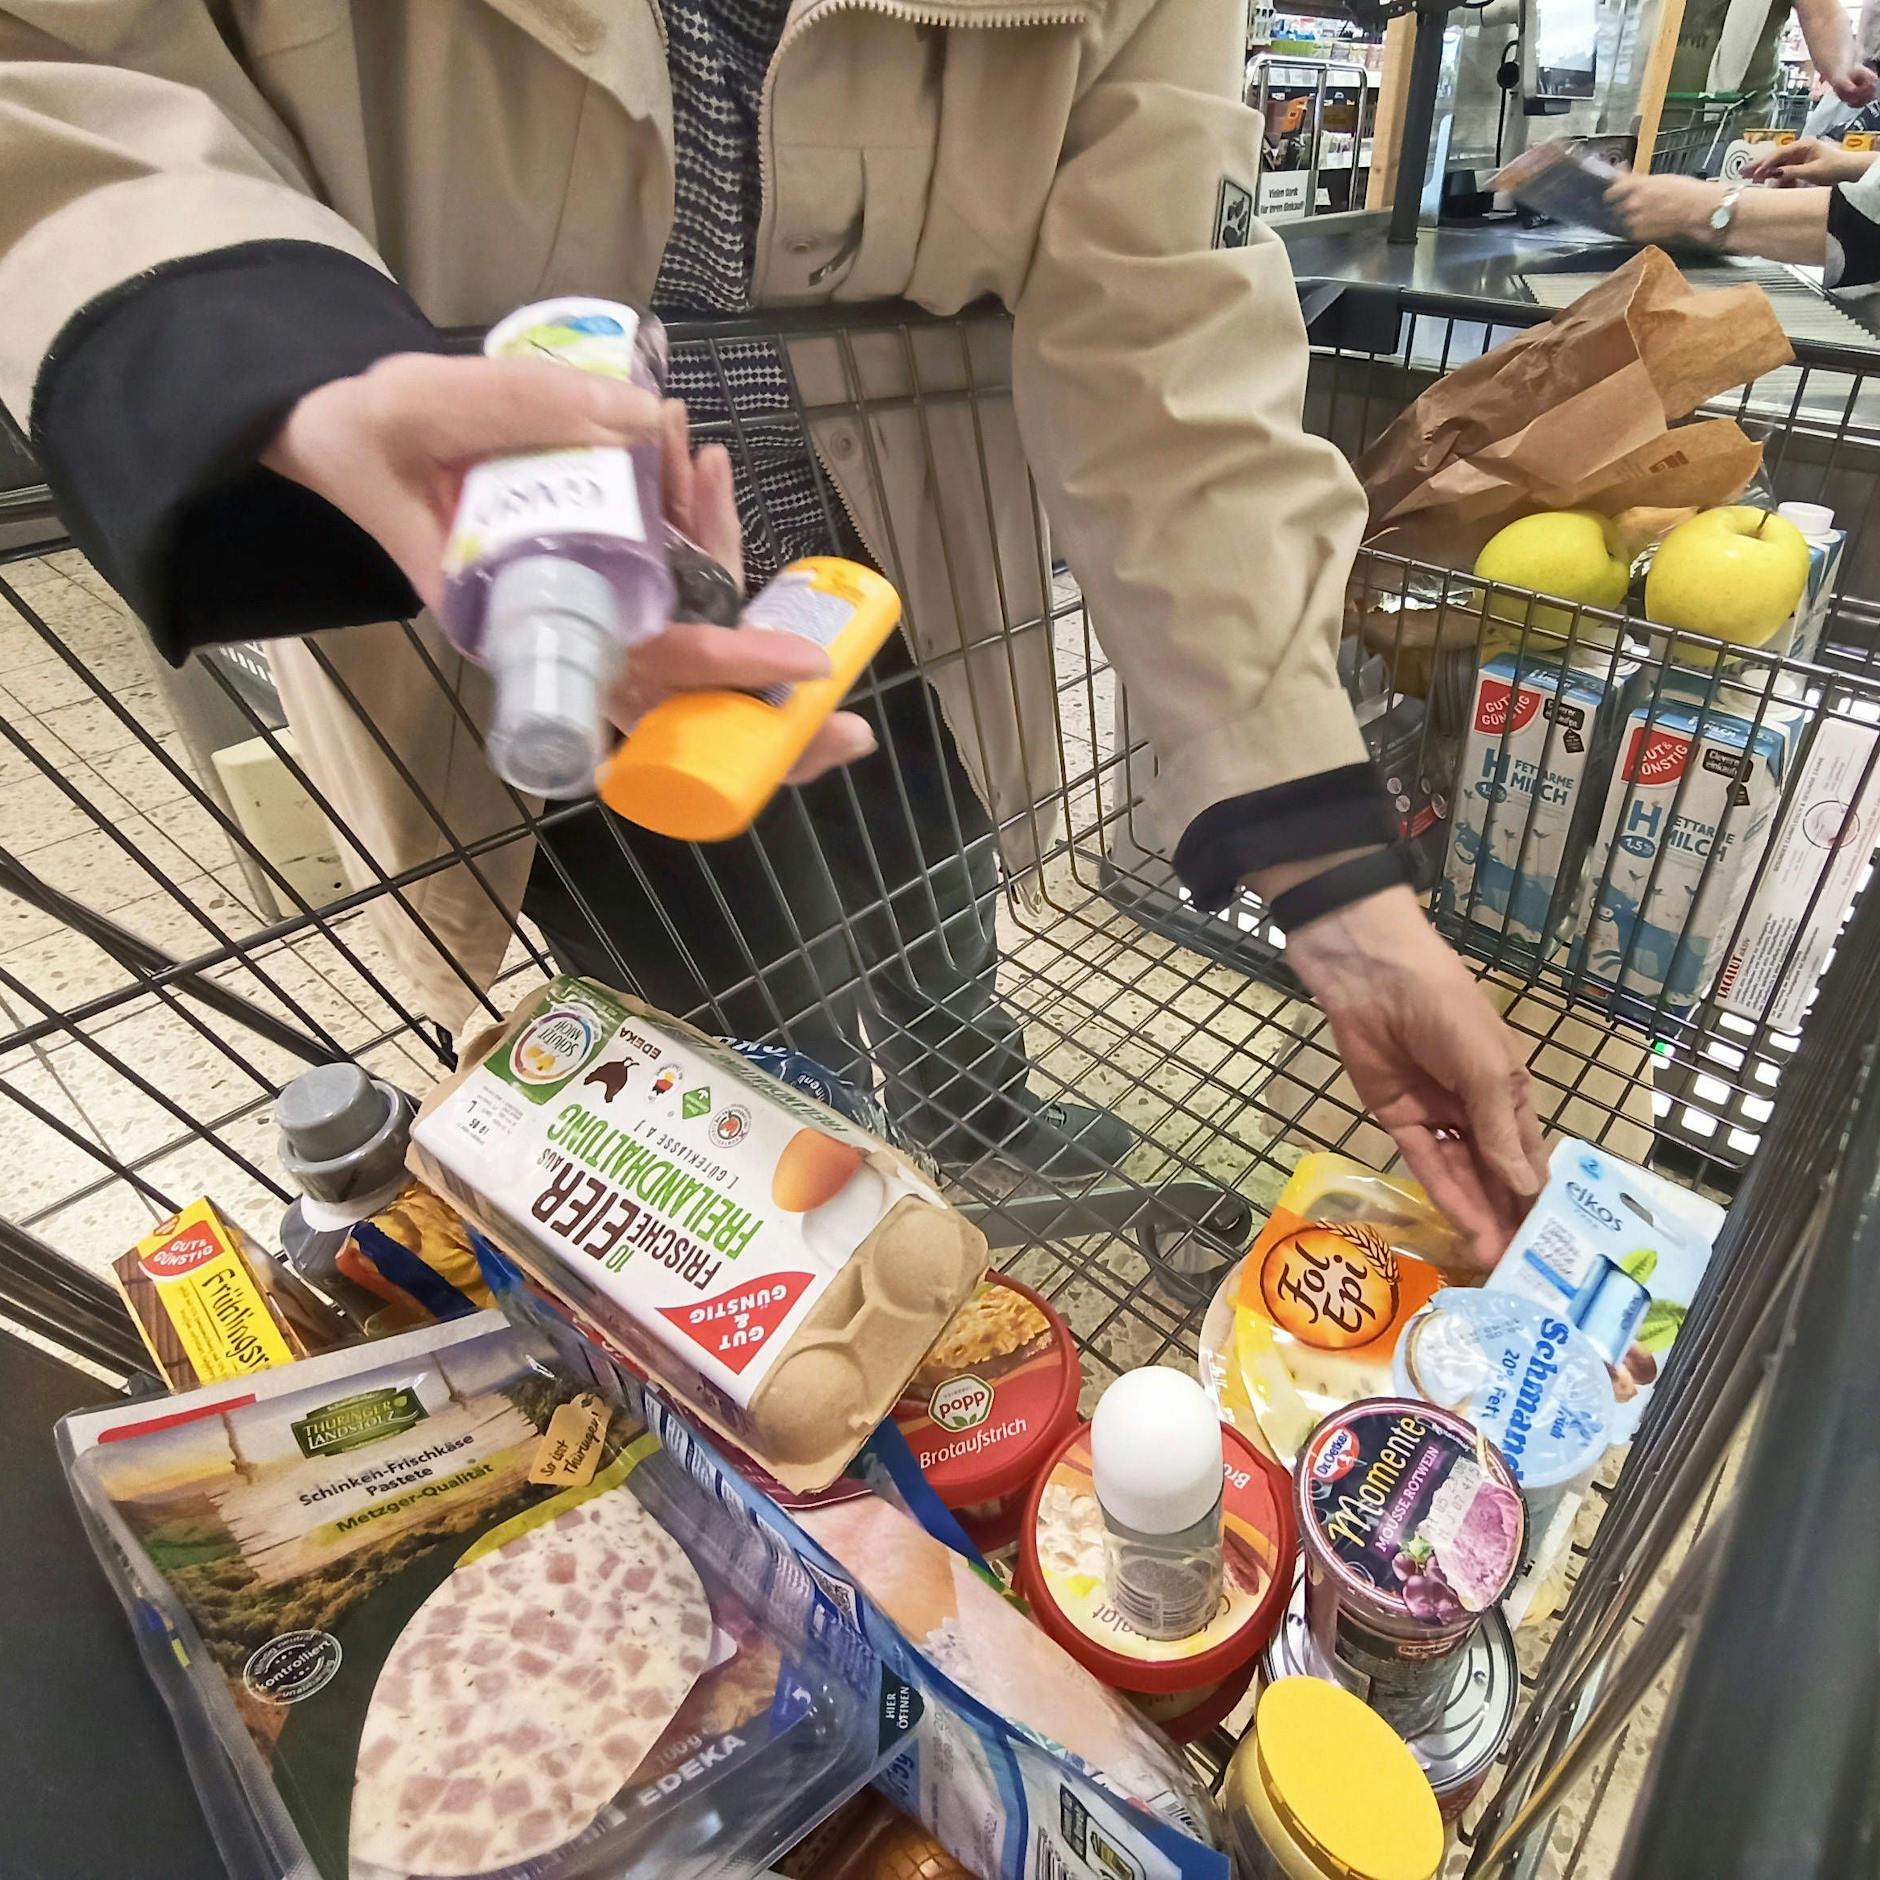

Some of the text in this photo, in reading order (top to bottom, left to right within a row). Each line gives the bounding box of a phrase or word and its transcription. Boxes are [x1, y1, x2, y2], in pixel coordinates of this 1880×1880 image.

[1482, 748, 1511, 783] H
[1514, 759, 1574, 790] FETARME
[1640, 744, 1688, 776] ÜNSTIG
[1627, 799, 1663, 838] H
[1674, 815, 1736, 845] ETTARE
[619, 1026, 662, 1061] EDEKA
[537, 1148, 564, 1173] AUS
[656, 1133, 728, 1182] GÜTEKLASSE
[547, 1103, 764, 1261] FREILANDHALTUNG
[531, 1162, 641, 1261] EIER
[154, 1246, 214, 1266] GÜNSTIG
[605, 1244, 635, 1273] 10
[627, 1213, 722, 1290] FRISCHE
[1277, 1240, 1330, 1324] Fol
[1322, 1254, 1376, 1334] Epi
[201, 1268, 270, 1369] Frühlingsr
[688, 1284, 787, 1324] GÜNSTIG
[734, 1313, 750, 1329] &
[719, 1325, 765, 1351] GUT
[939, 1391, 985, 1419] popp
[1502, 1318, 1569, 1481] Schmand
[920, 1418, 1028, 1470] Brotaufstrich
[298, 1433, 475, 1507] Schinken-Frischkäse
[365, 1466, 434, 1497] Pastete
[540, 1461, 557, 1477] So
[1327, 1415, 1426, 1547] Momente
[335, 1463, 495, 1533] Metzger-Qualität
[1375, 1446, 1440, 1552] MOUSSE ROTWEIN
[885, 1693, 896, 1720] HIER
[636, 1734, 748, 1807] EDEKA
